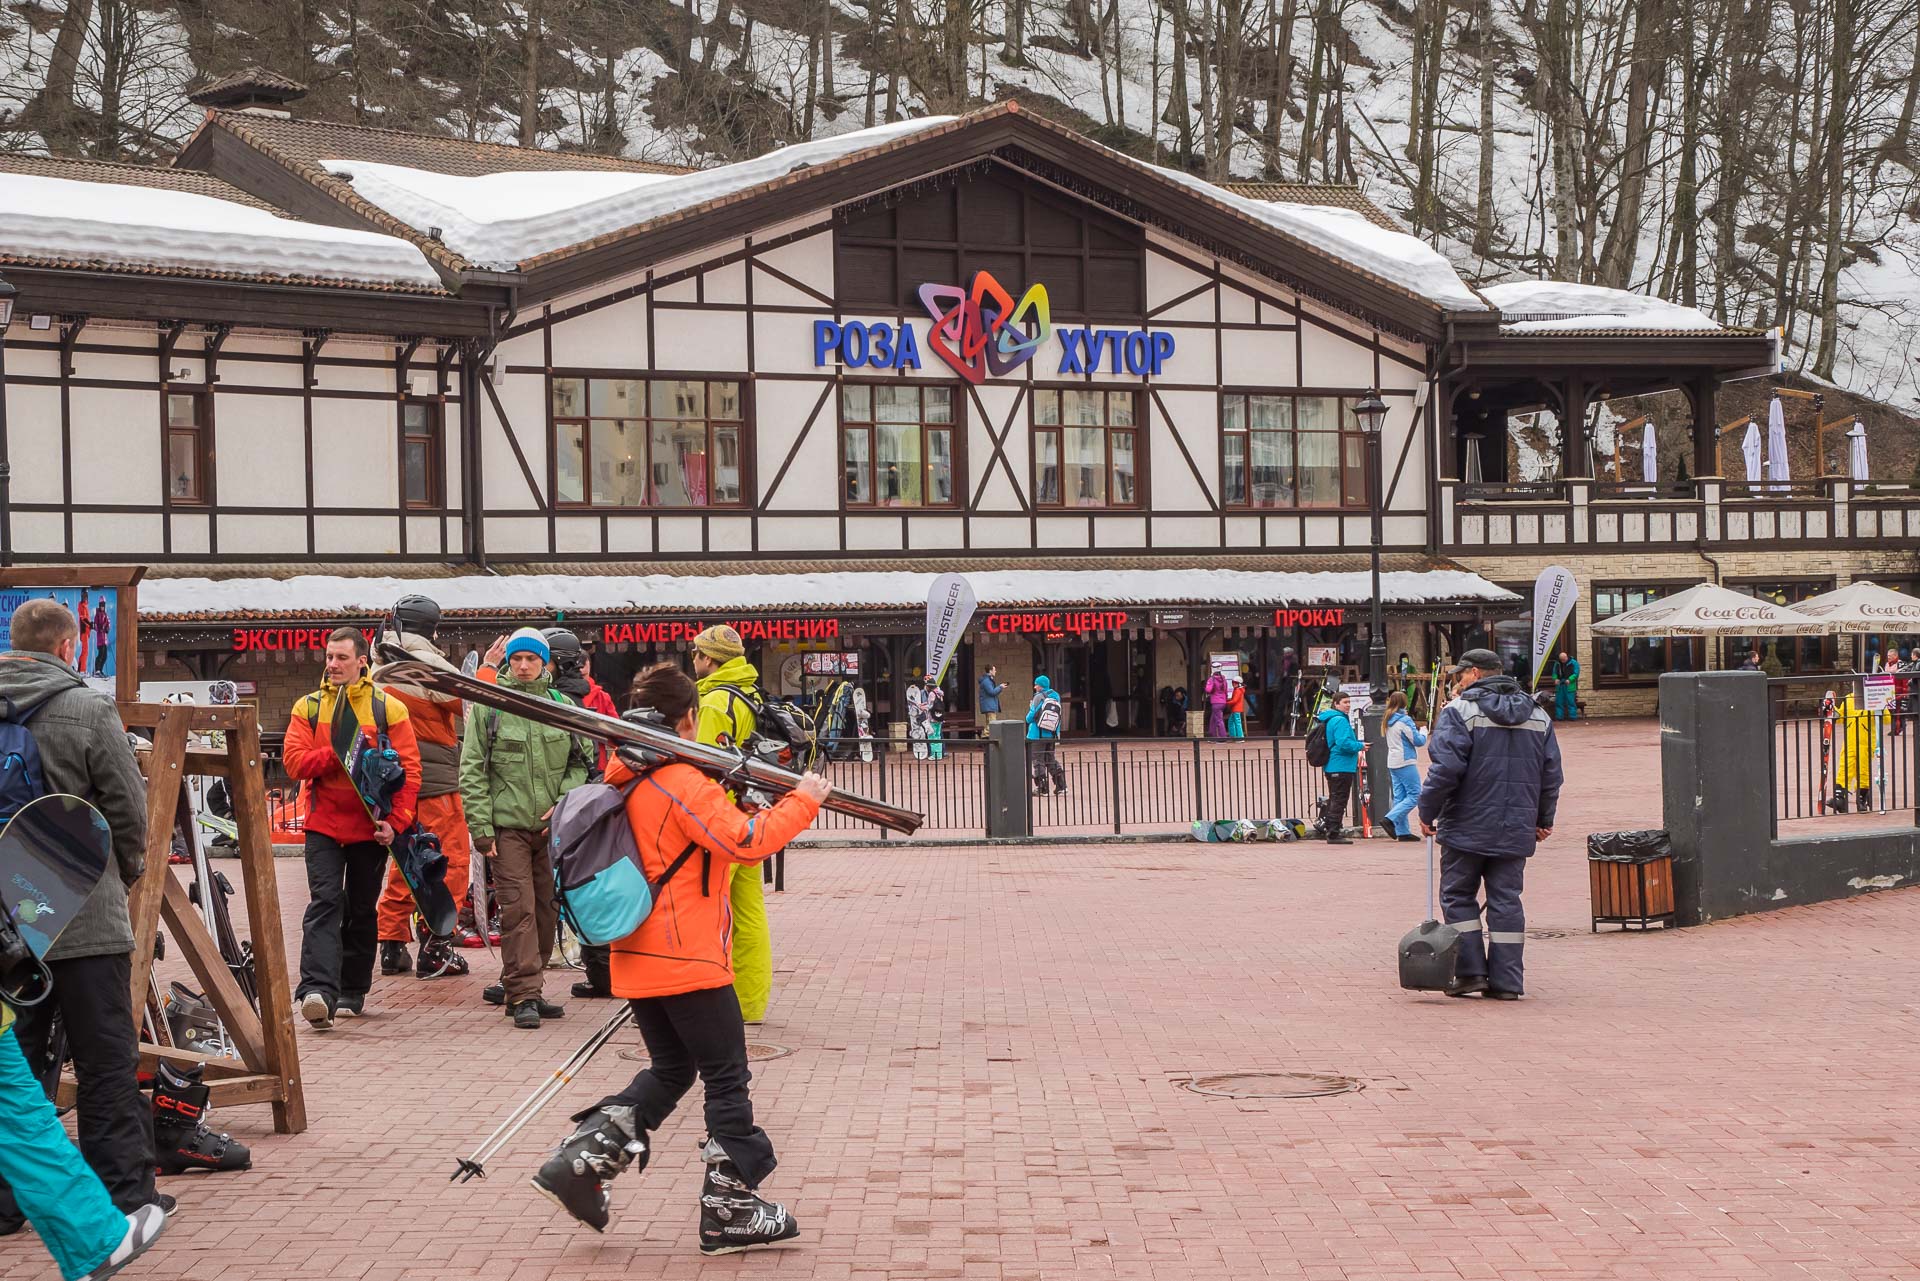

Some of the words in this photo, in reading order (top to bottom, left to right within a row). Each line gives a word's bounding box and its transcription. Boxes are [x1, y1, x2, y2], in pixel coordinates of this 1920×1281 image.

[814, 319, 922, 369] РОЗА
[1057, 328, 1176, 376] ХУТОР
[1275, 609, 1344, 627] ПРОКАТ
[1536, 574, 1565, 656] WINTERSTEIGER
[1860, 604, 1920, 617] Coca-Co
[604, 621, 704, 644] КАМЕРЫ
[930, 582, 961, 676] WINTERSTEIGER
[986, 613, 1062, 633] СЕРВИС
[1066, 611, 1127, 635] ЦЕНТР
